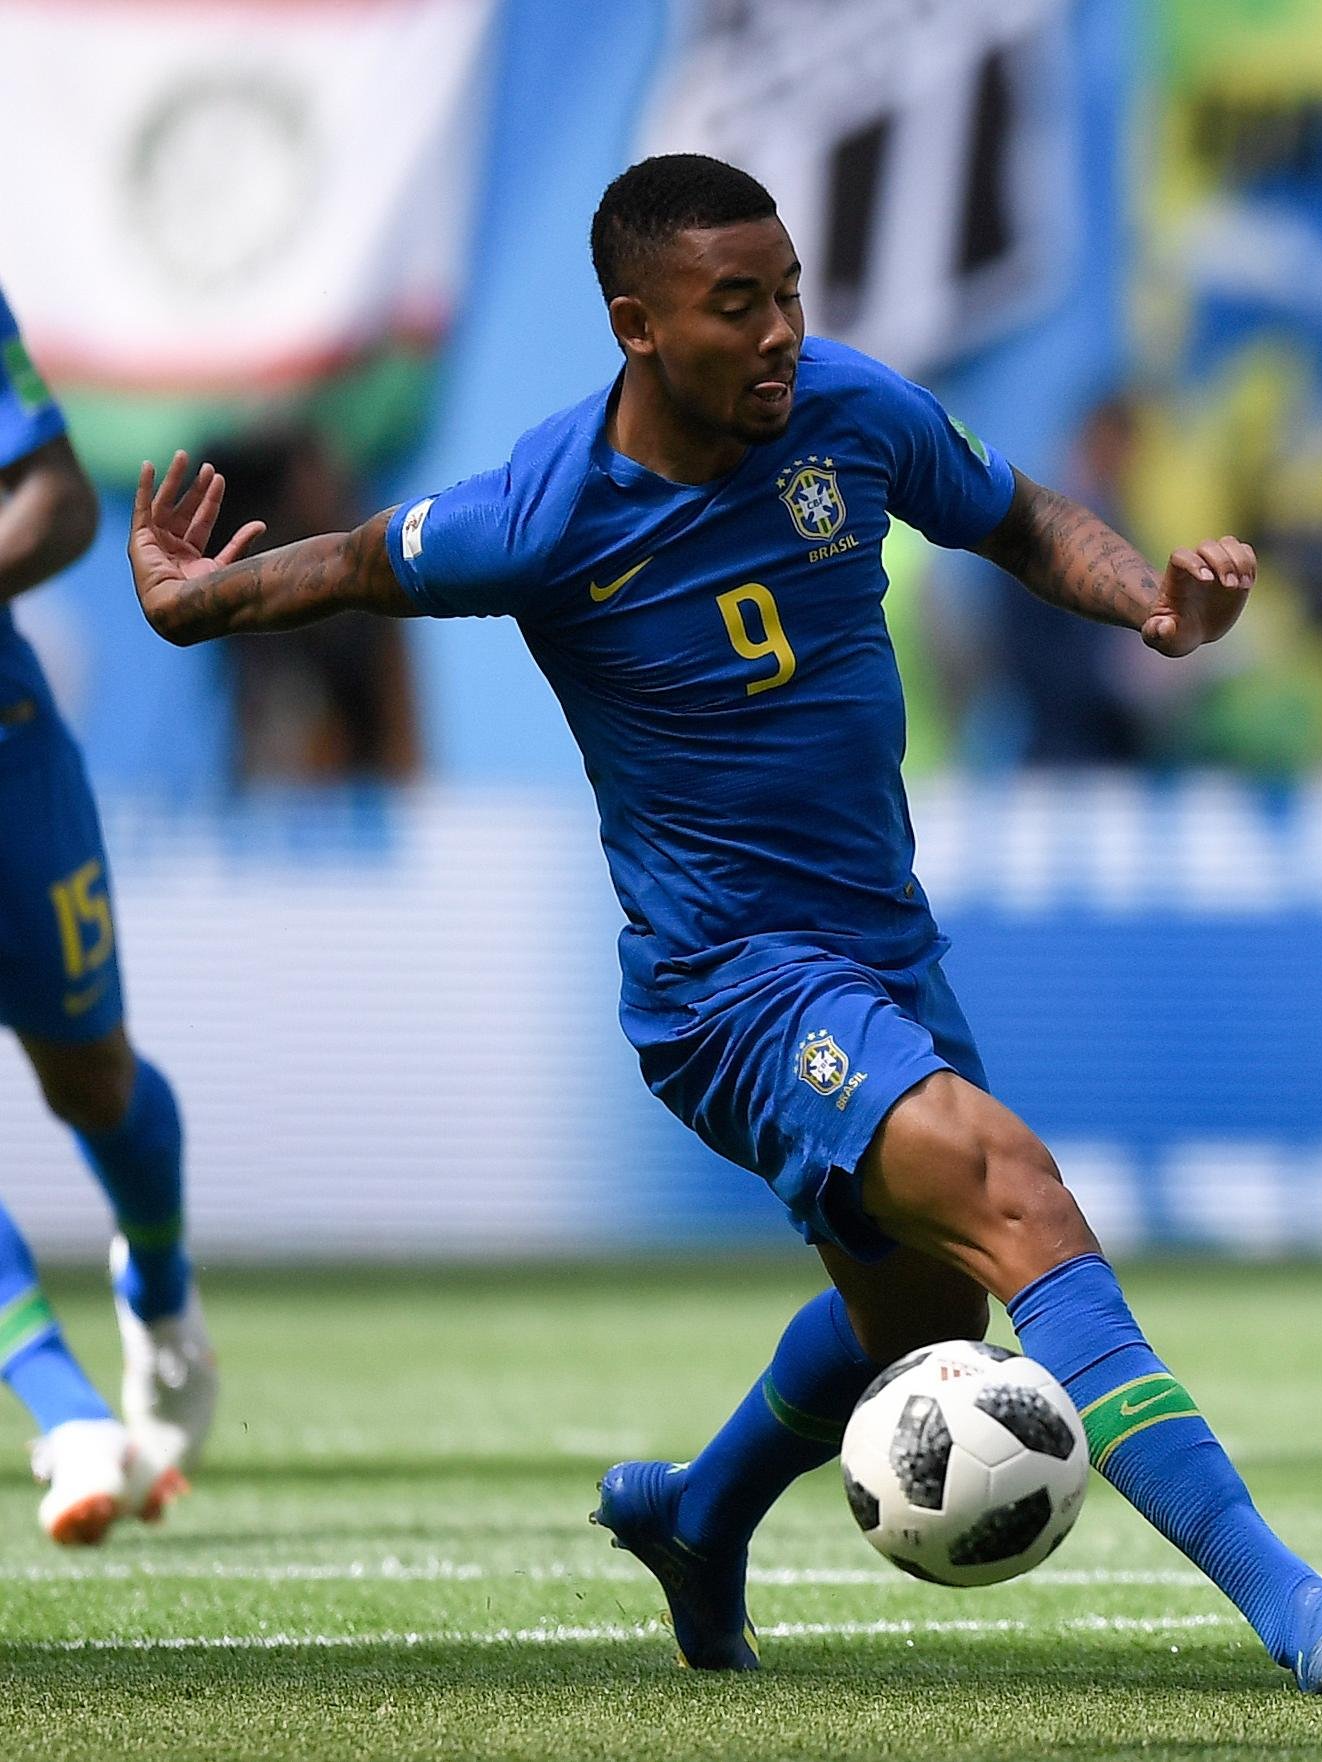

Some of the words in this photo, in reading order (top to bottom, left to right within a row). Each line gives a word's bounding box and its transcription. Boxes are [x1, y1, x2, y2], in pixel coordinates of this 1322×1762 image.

[806, 496, 824, 510] CBF
[809, 534, 859, 563] BRASIL
[715, 582, 796, 696] 9
[51, 858, 113, 979] 15
[836, 1072, 868, 1111] BRASIL
